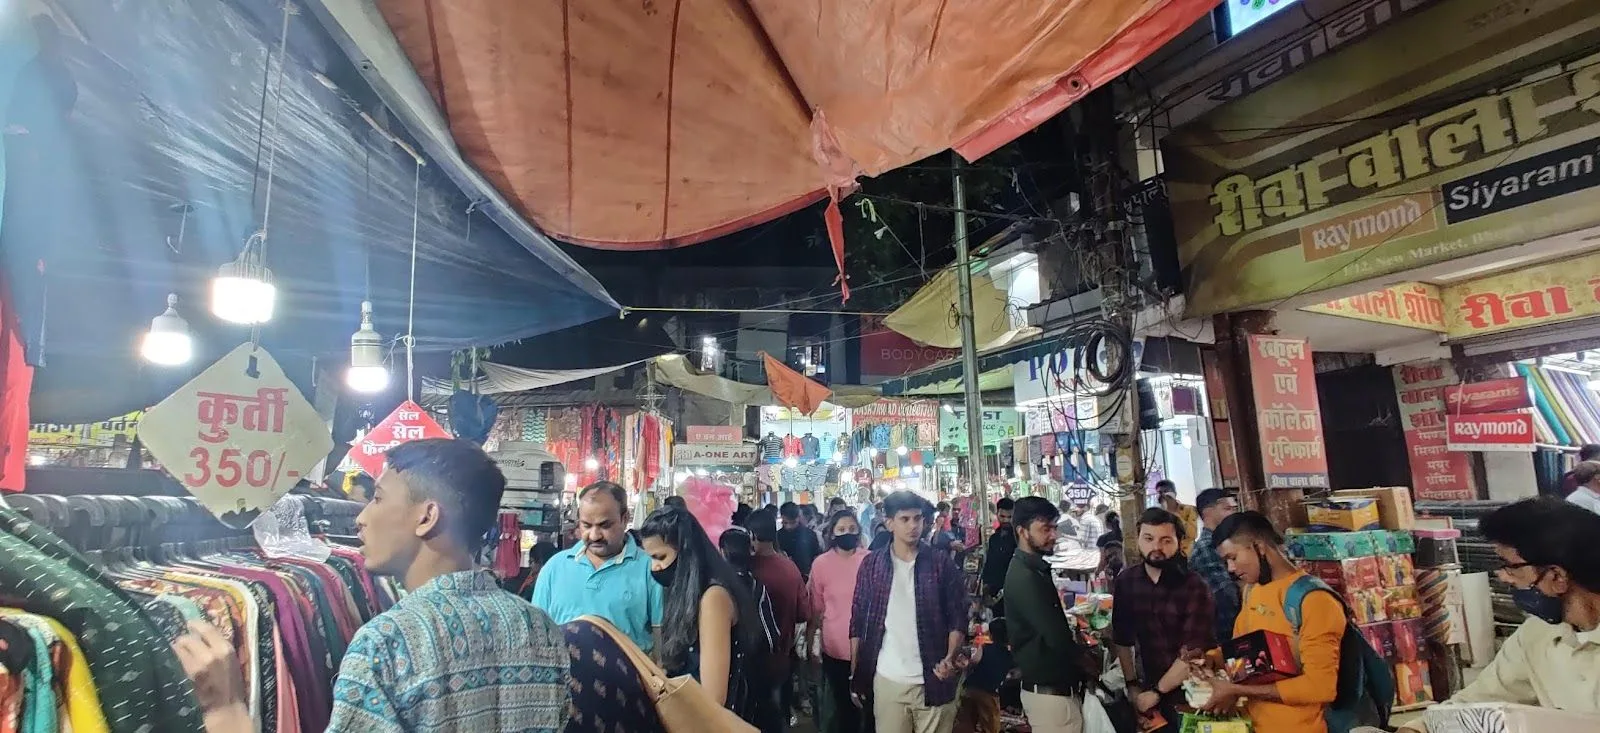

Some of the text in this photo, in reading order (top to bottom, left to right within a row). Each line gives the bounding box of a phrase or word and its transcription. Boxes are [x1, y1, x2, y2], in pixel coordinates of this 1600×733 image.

[1450, 145, 1600, 210] Siyaram
[1313, 199, 1422, 250] Raymond
[1460, 287, 1573, 330] रीवा
[881, 348, 962, 361] BODYCAR
[1256, 337, 1306, 367] स्कूल
[1272, 367, 1299, 395] एवं
[197, 387, 289, 443] कुर्ती
[398, 408, 421, 421] सेल
[1261, 403, 1318, 431] कॉलेज
[1453, 418, 1528, 439] Raymond
[391, 421, 425, 440] सेल
[184, 446, 299, 491] 350/-
[693, 450, 756, 459] A-ONE ART
